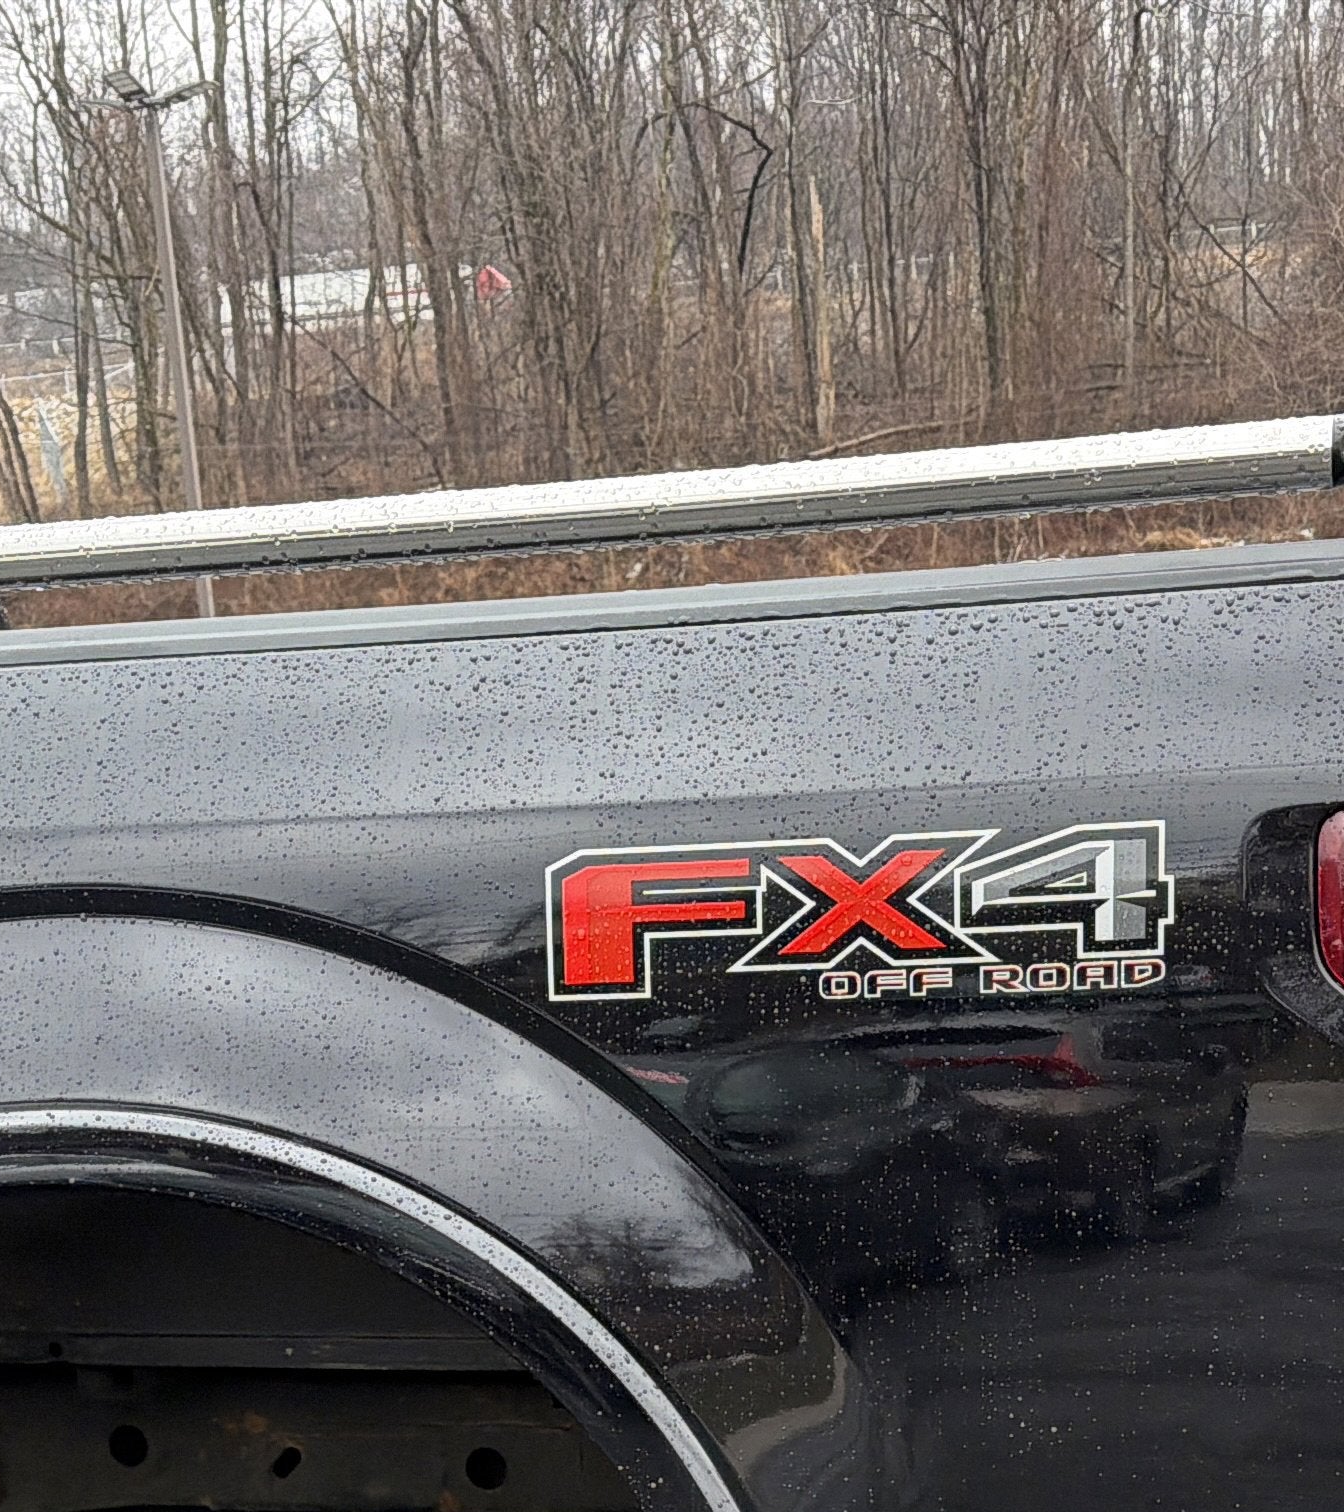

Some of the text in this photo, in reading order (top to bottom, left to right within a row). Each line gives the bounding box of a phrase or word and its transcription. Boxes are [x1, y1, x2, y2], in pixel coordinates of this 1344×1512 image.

[545, 820, 1175, 1002] FX4
[818, 959, 1167, 1000] OFF ROAD
